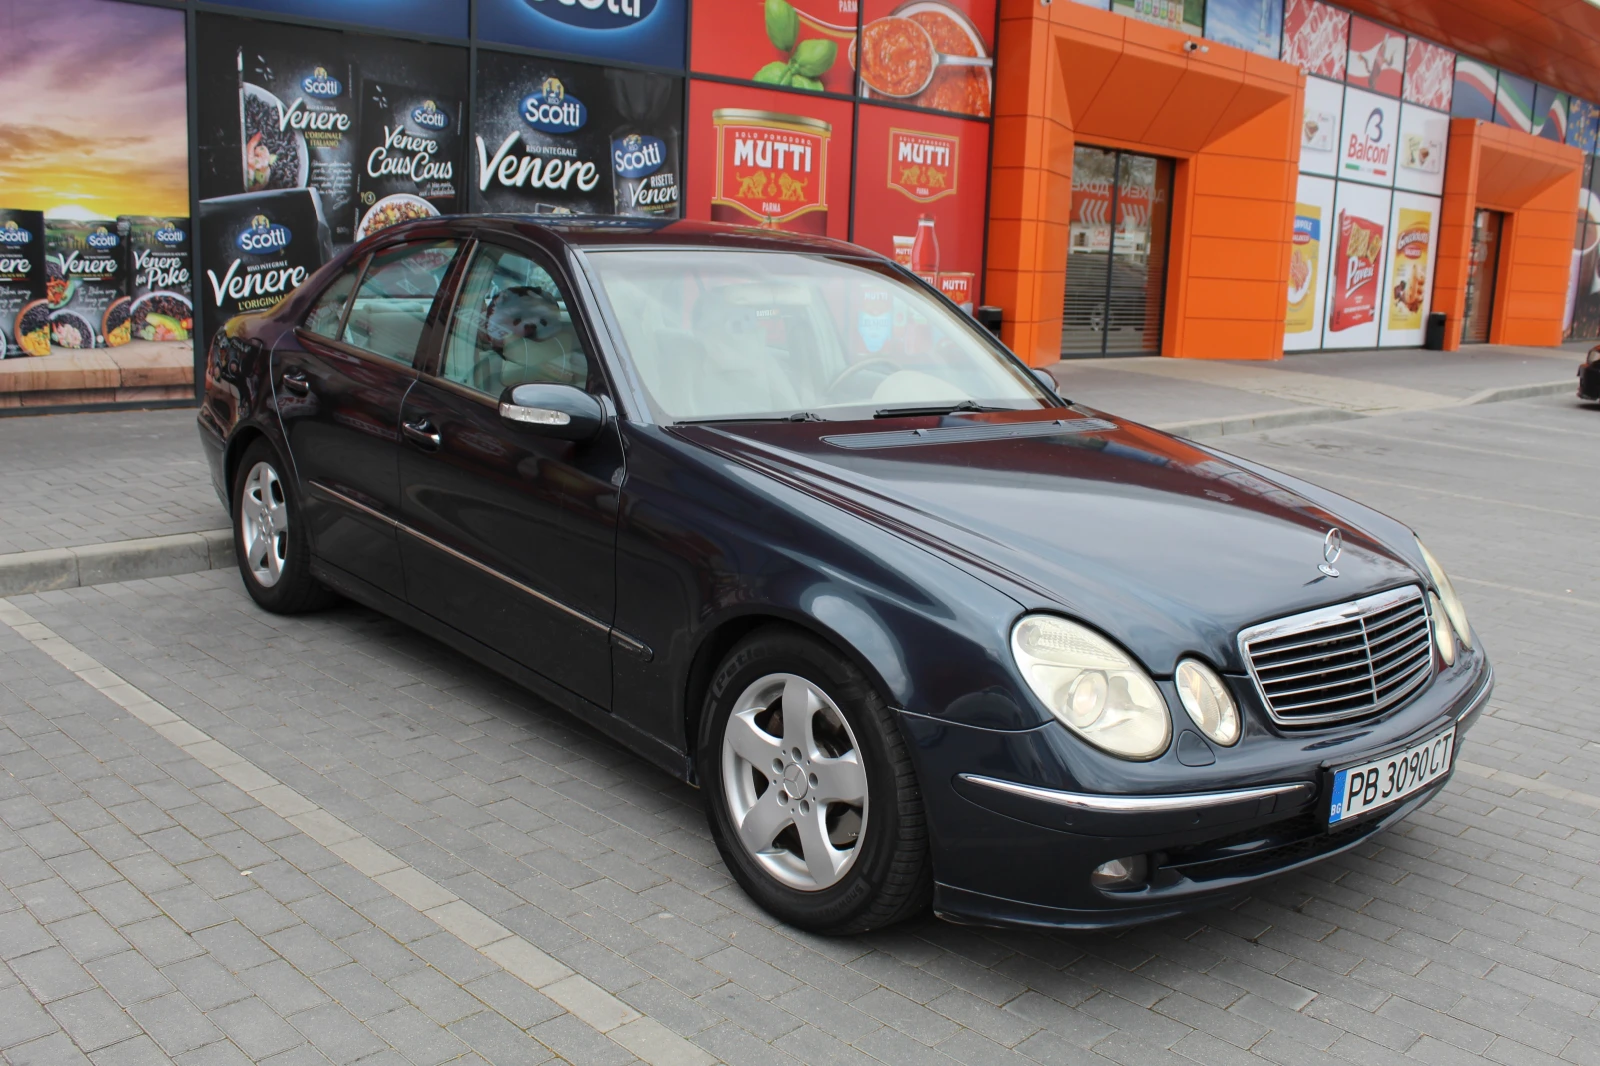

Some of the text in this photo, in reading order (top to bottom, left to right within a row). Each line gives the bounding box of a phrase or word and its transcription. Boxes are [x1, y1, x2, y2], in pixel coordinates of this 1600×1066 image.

[838, 0, 858, 13] PARM
[304, 78, 338, 95] Scotti
[276, 97, 351, 132] Venere
[414, 109, 444, 126] Scotti
[525, 98, 580, 127] Scotti
[304, 131, 342, 140] L'ORIGINALE
[309, 139, 339, 147] ITALIANO
[384, 124, 438, 154] Venere
[735, 131, 759, 139] SOLO
[525, 144, 578, 157] RISO INTEGRALE
[614, 142, 661, 172] Scotti
[733, 138, 812, 173] MUTTI
[898, 141, 950, 168] MUTTI
[1347, 133, 1391, 165] Balconi
[475, 130, 599, 192] Venere
[650, 173, 674, 187] RISETTE
[762, 202, 781, 213] PARMA
[0, 230, 29, 243] Scotti
[89, 233, 117, 247] Scotti
[157, 230, 183, 242] Scotti
[241, 228, 287, 250] Scotti
[0, 256, 31, 274] ere
[58, 250, 118, 275] Venere
[133, 249, 181, 270] Venere
[145, 266, 190, 289] Poke
[1346, 255, 1374, 290] Pavesi
[207, 257, 309, 307] Venere
[942, 279, 967, 291] MUTTI
[238, 294, 287, 311] L'ORIGINAL
[1346, 732, 1453, 812] PB 3090 CT
[1331, 802, 1342, 815] BG
